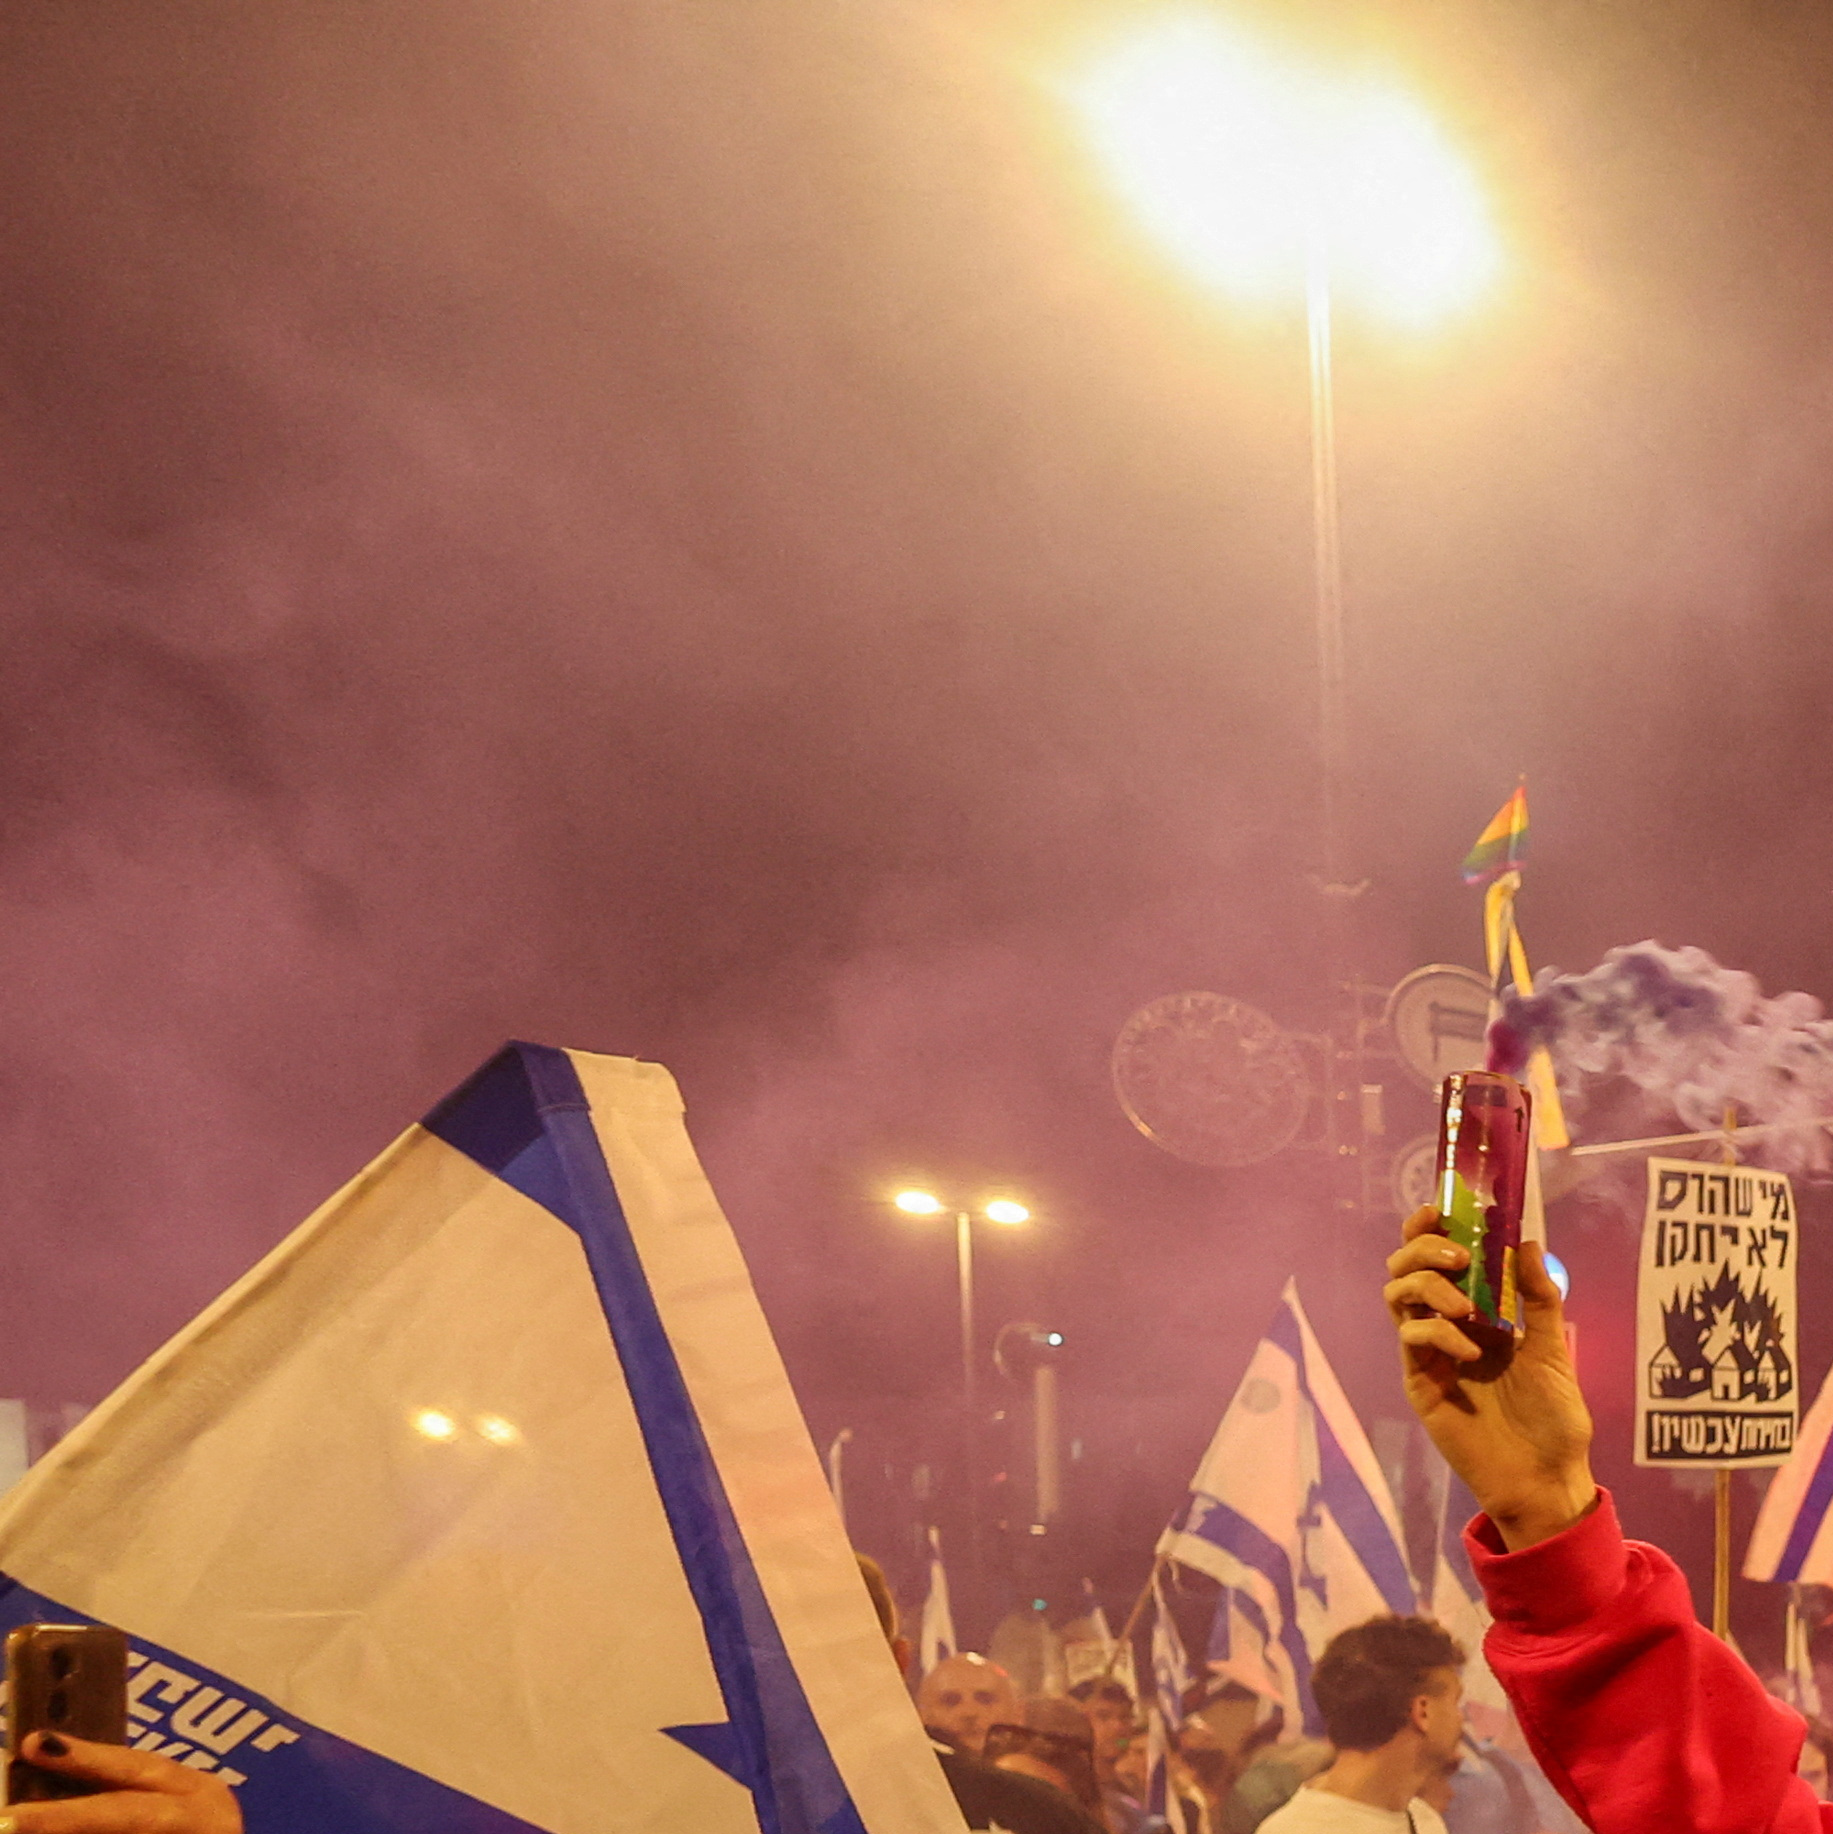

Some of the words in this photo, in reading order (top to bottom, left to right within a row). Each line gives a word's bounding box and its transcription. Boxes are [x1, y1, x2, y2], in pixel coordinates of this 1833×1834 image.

[1758, 1179, 1790, 1221] מי
[1655, 1219, 1739, 1268] יתקן
[1747, 1223, 1790, 1268] לא
[1651, 1412, 1741, 1455] עכשיו!
